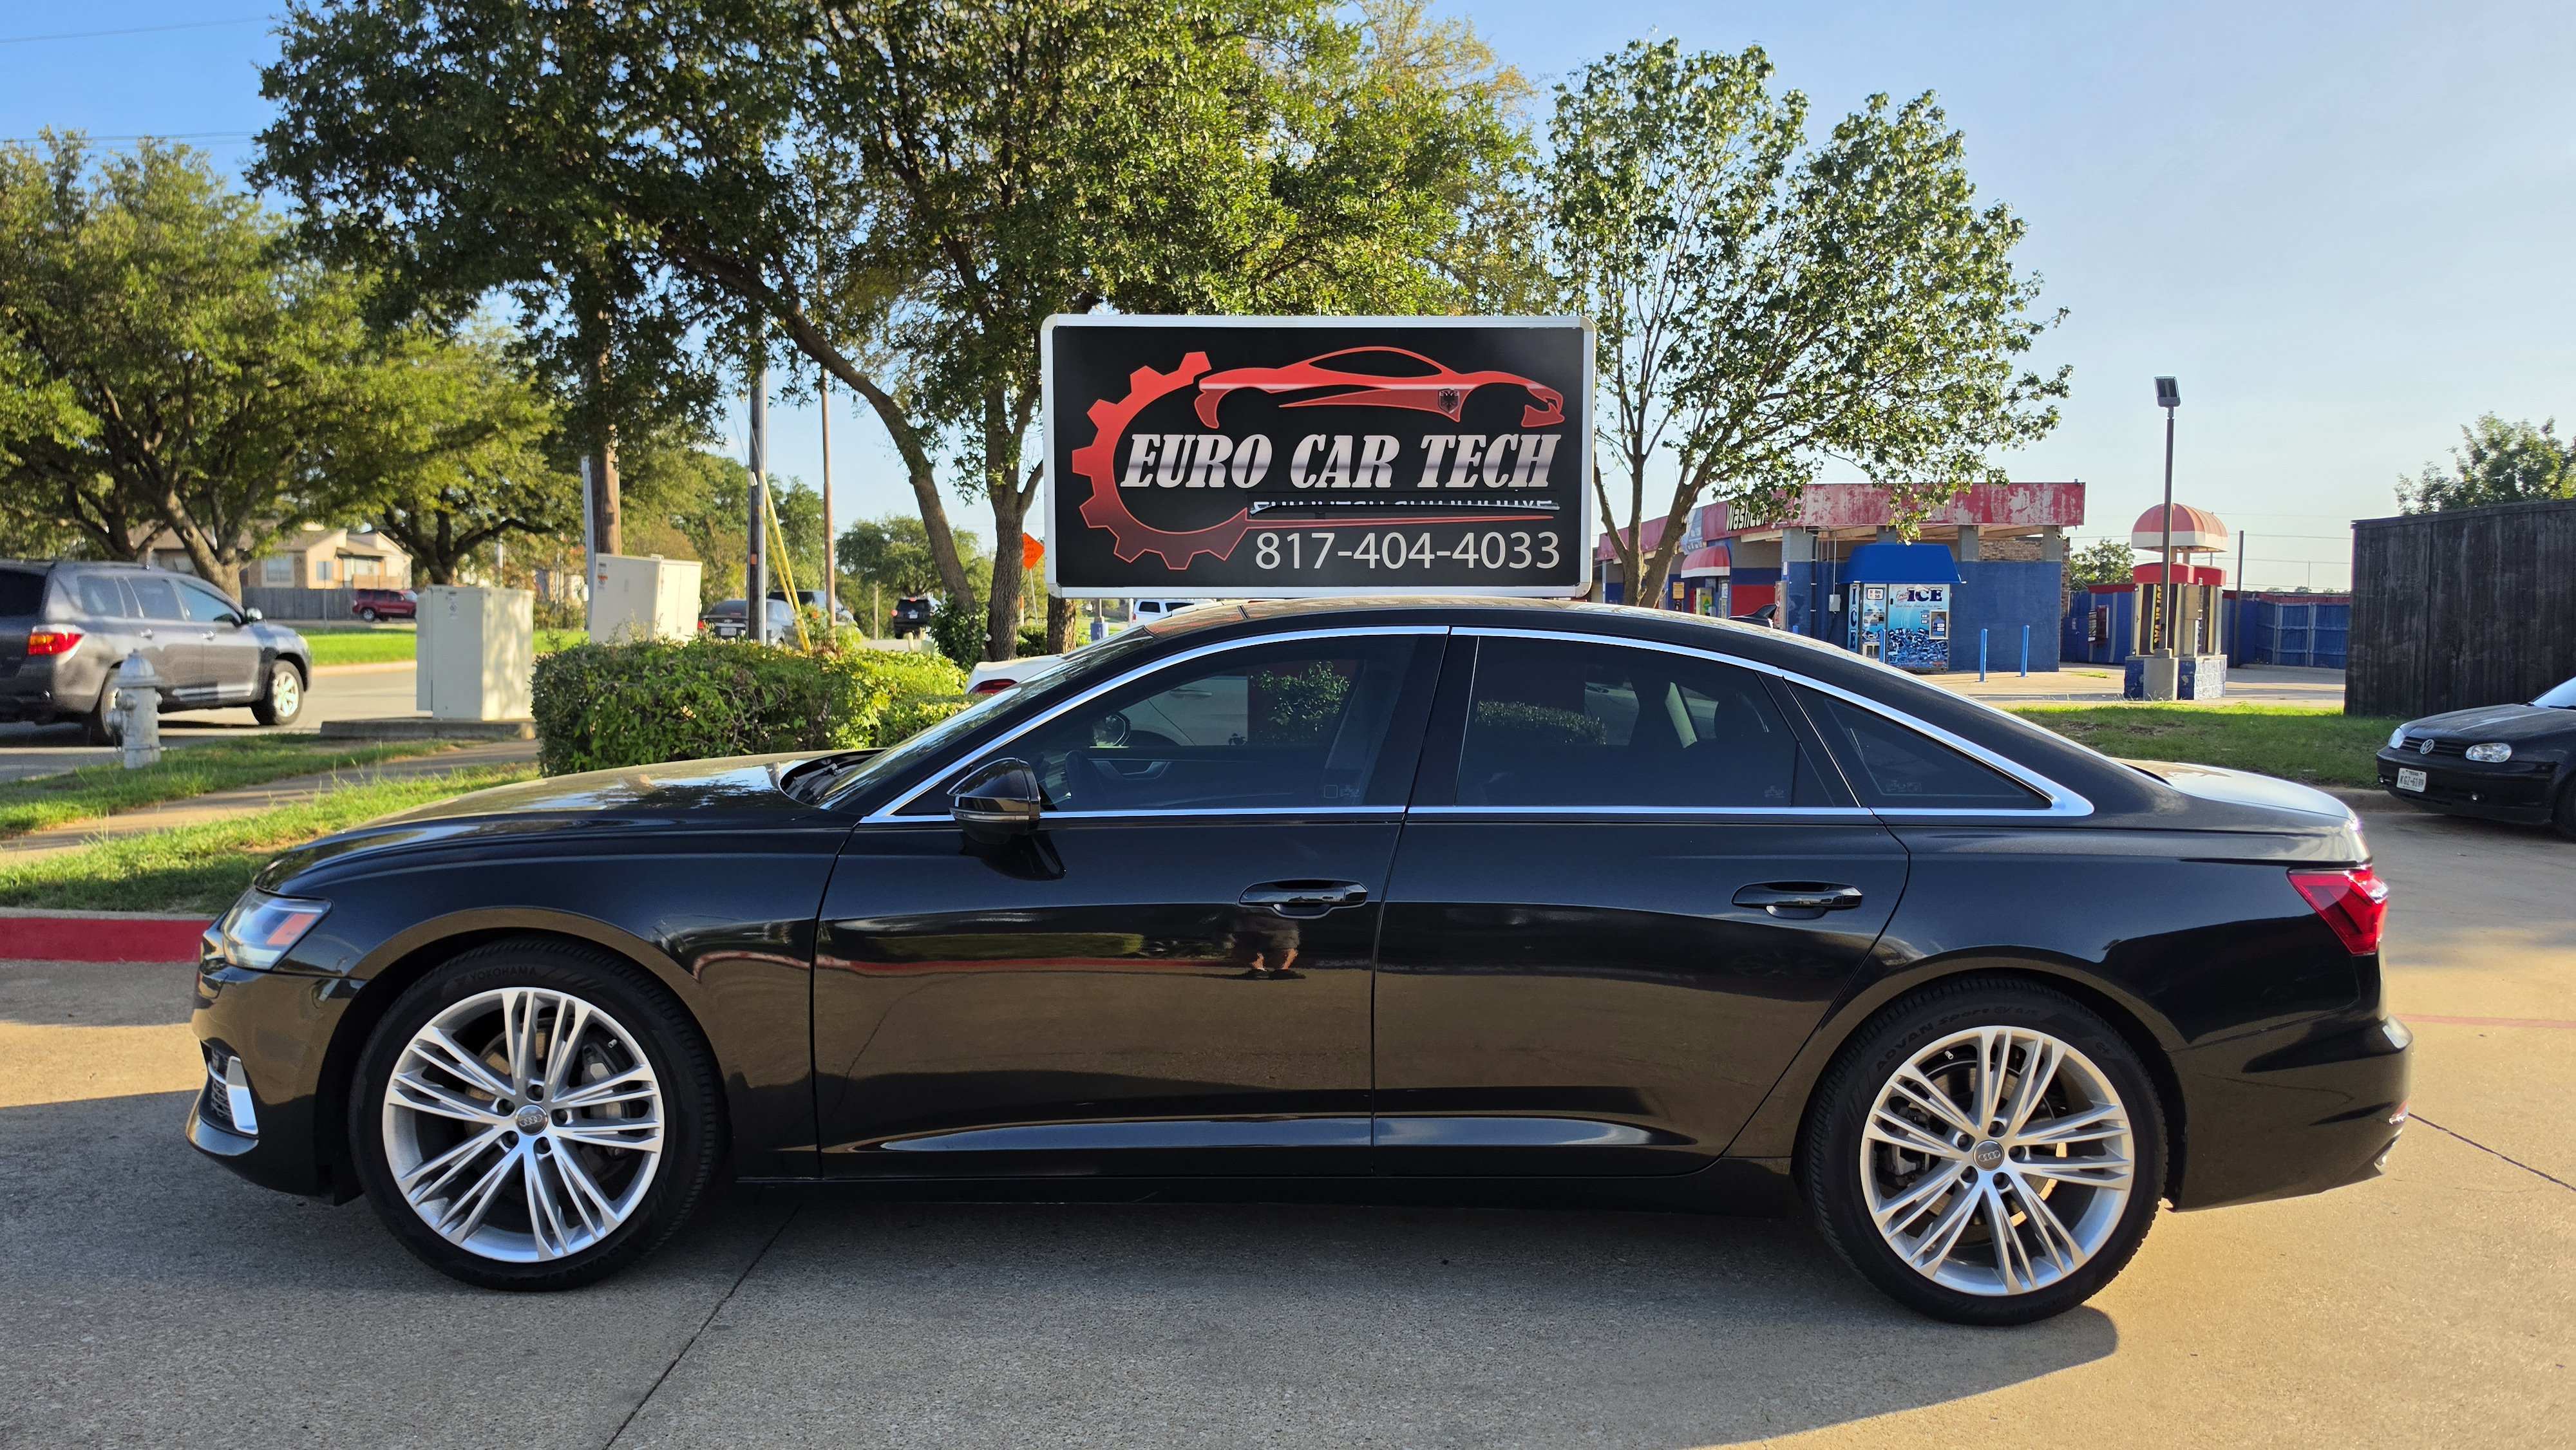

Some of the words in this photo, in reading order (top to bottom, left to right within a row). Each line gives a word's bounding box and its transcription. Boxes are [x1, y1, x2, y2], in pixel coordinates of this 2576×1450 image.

[1120, 434, 1273, 488] EURO
[1290, 434, 1399, 488] CAR
[1417, 434, 1561, 487] TECH
[1256, 531, 1559, 569] 817-404-4033
[1907, 586, 1943, 602] ICE
[469, 966, 536, 979] YOKOHAMA
[1876, 1022, 1934, 1071] ADVAN
